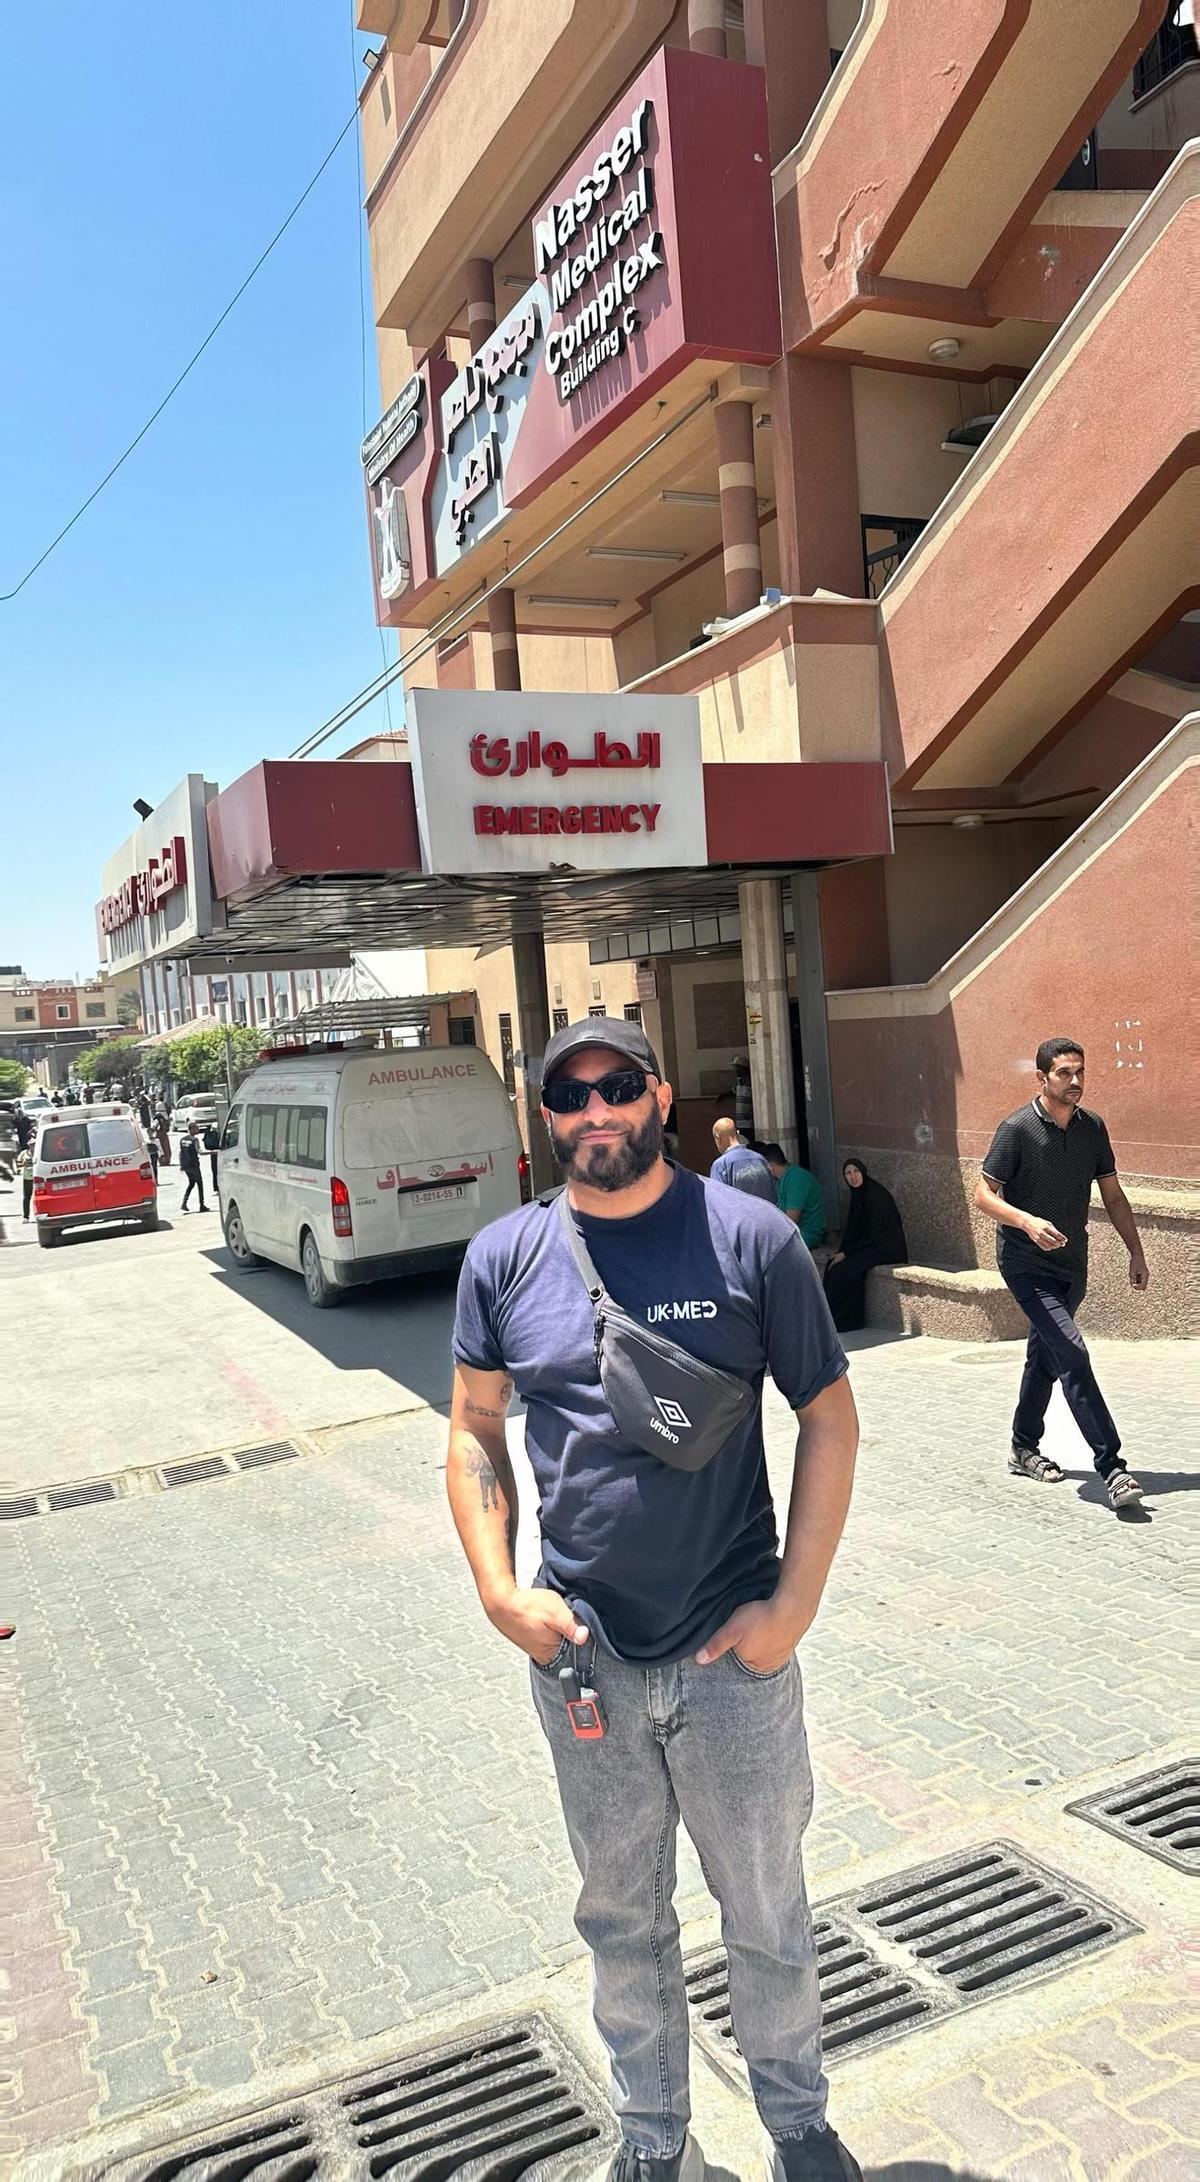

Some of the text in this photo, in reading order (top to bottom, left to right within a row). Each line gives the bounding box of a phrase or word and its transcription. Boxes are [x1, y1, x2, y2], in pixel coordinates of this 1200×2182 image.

[535, 99, 654, 274] Nasser
[551, 167, 654, 313] Medical
[545, 231, 664, 376] Complex
[560, 306, 641, 400] Building C
[469, 731, 661, 777] الطوارئ
[473, 804, 661, 835] EMERGENCY
[368, 1064, 477, 1086] AMBULANCE
[50, 1157, 129, 1174] AMBULANCE
[647, 1300, 718, 1323] UK-MED
[650, 1417, 680, 1444] umbro
